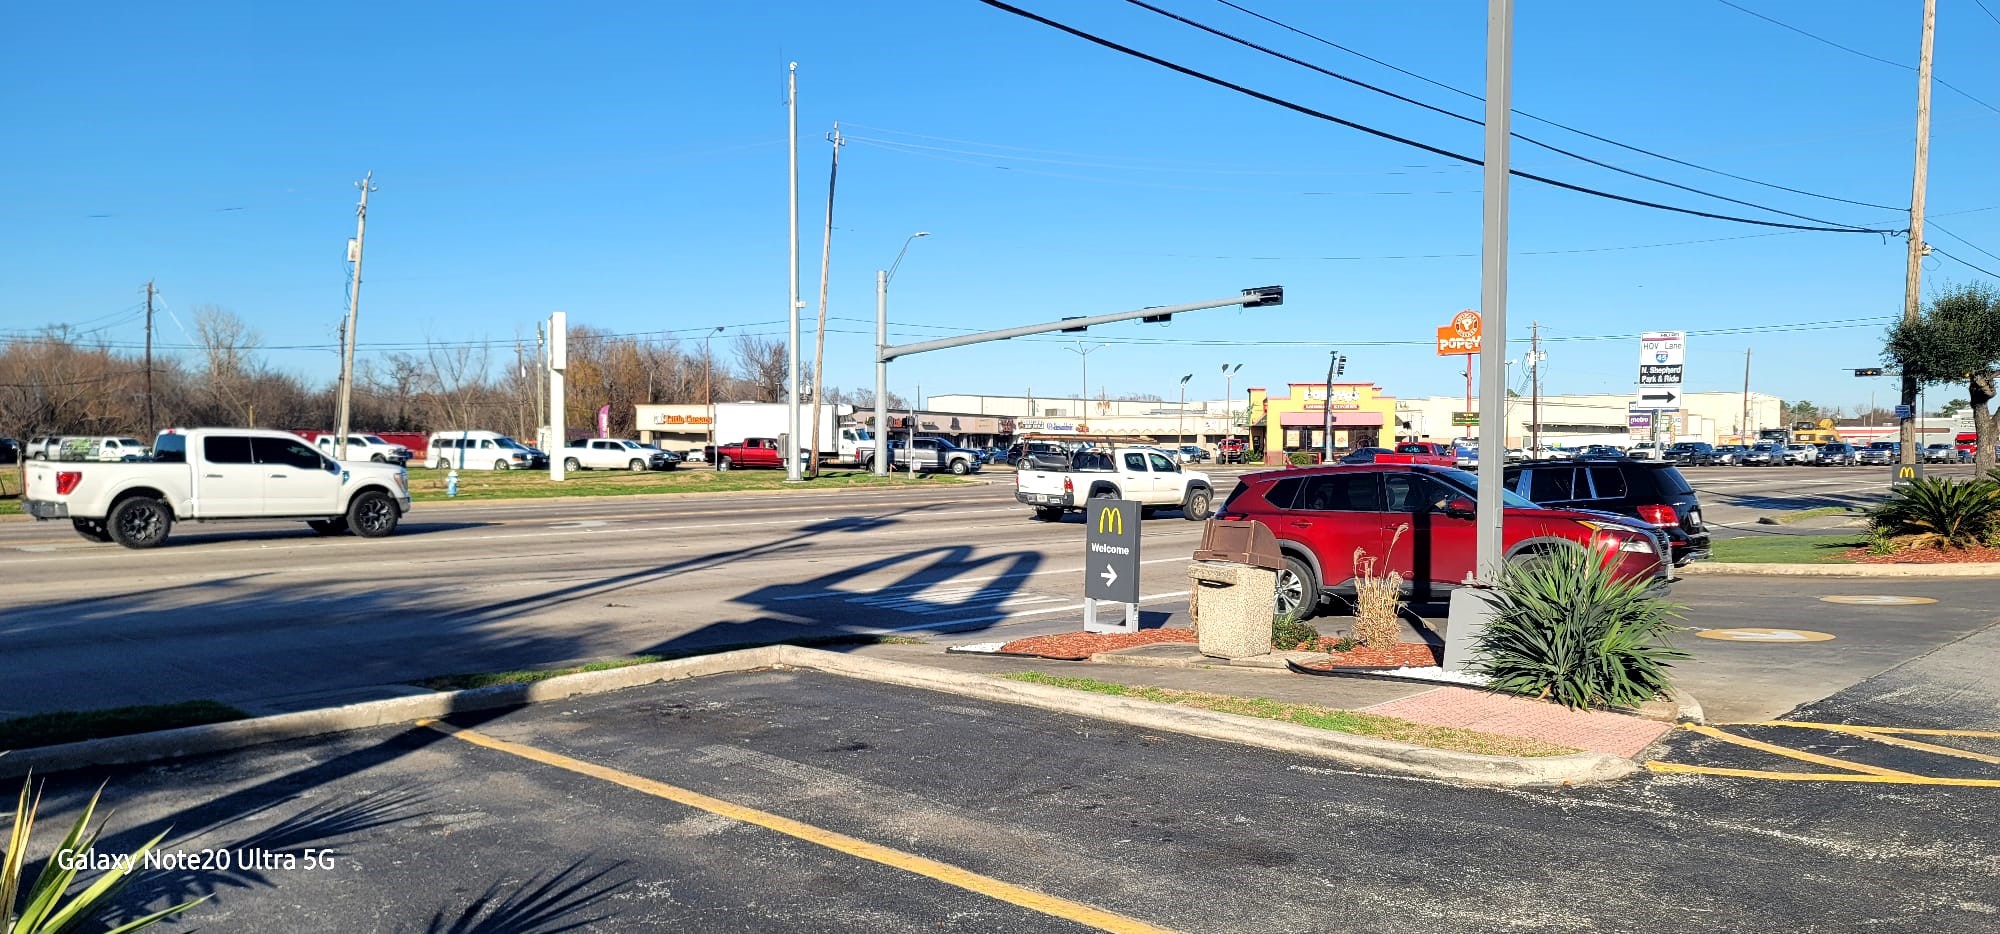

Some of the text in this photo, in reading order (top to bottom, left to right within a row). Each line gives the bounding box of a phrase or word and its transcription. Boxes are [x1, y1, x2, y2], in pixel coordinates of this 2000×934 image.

[1439, 336, 1481, 350] POPEY
[1643, 342, 1659, 350] HOV
[1641, 366, 1648, 374] N.
[1641, 374, 1656, 383] Park
[1664, 374, 1680, 382] Ride
[1630, 416, 1649, 424] metro
[1091, 542, 1130, 555] Welcome
